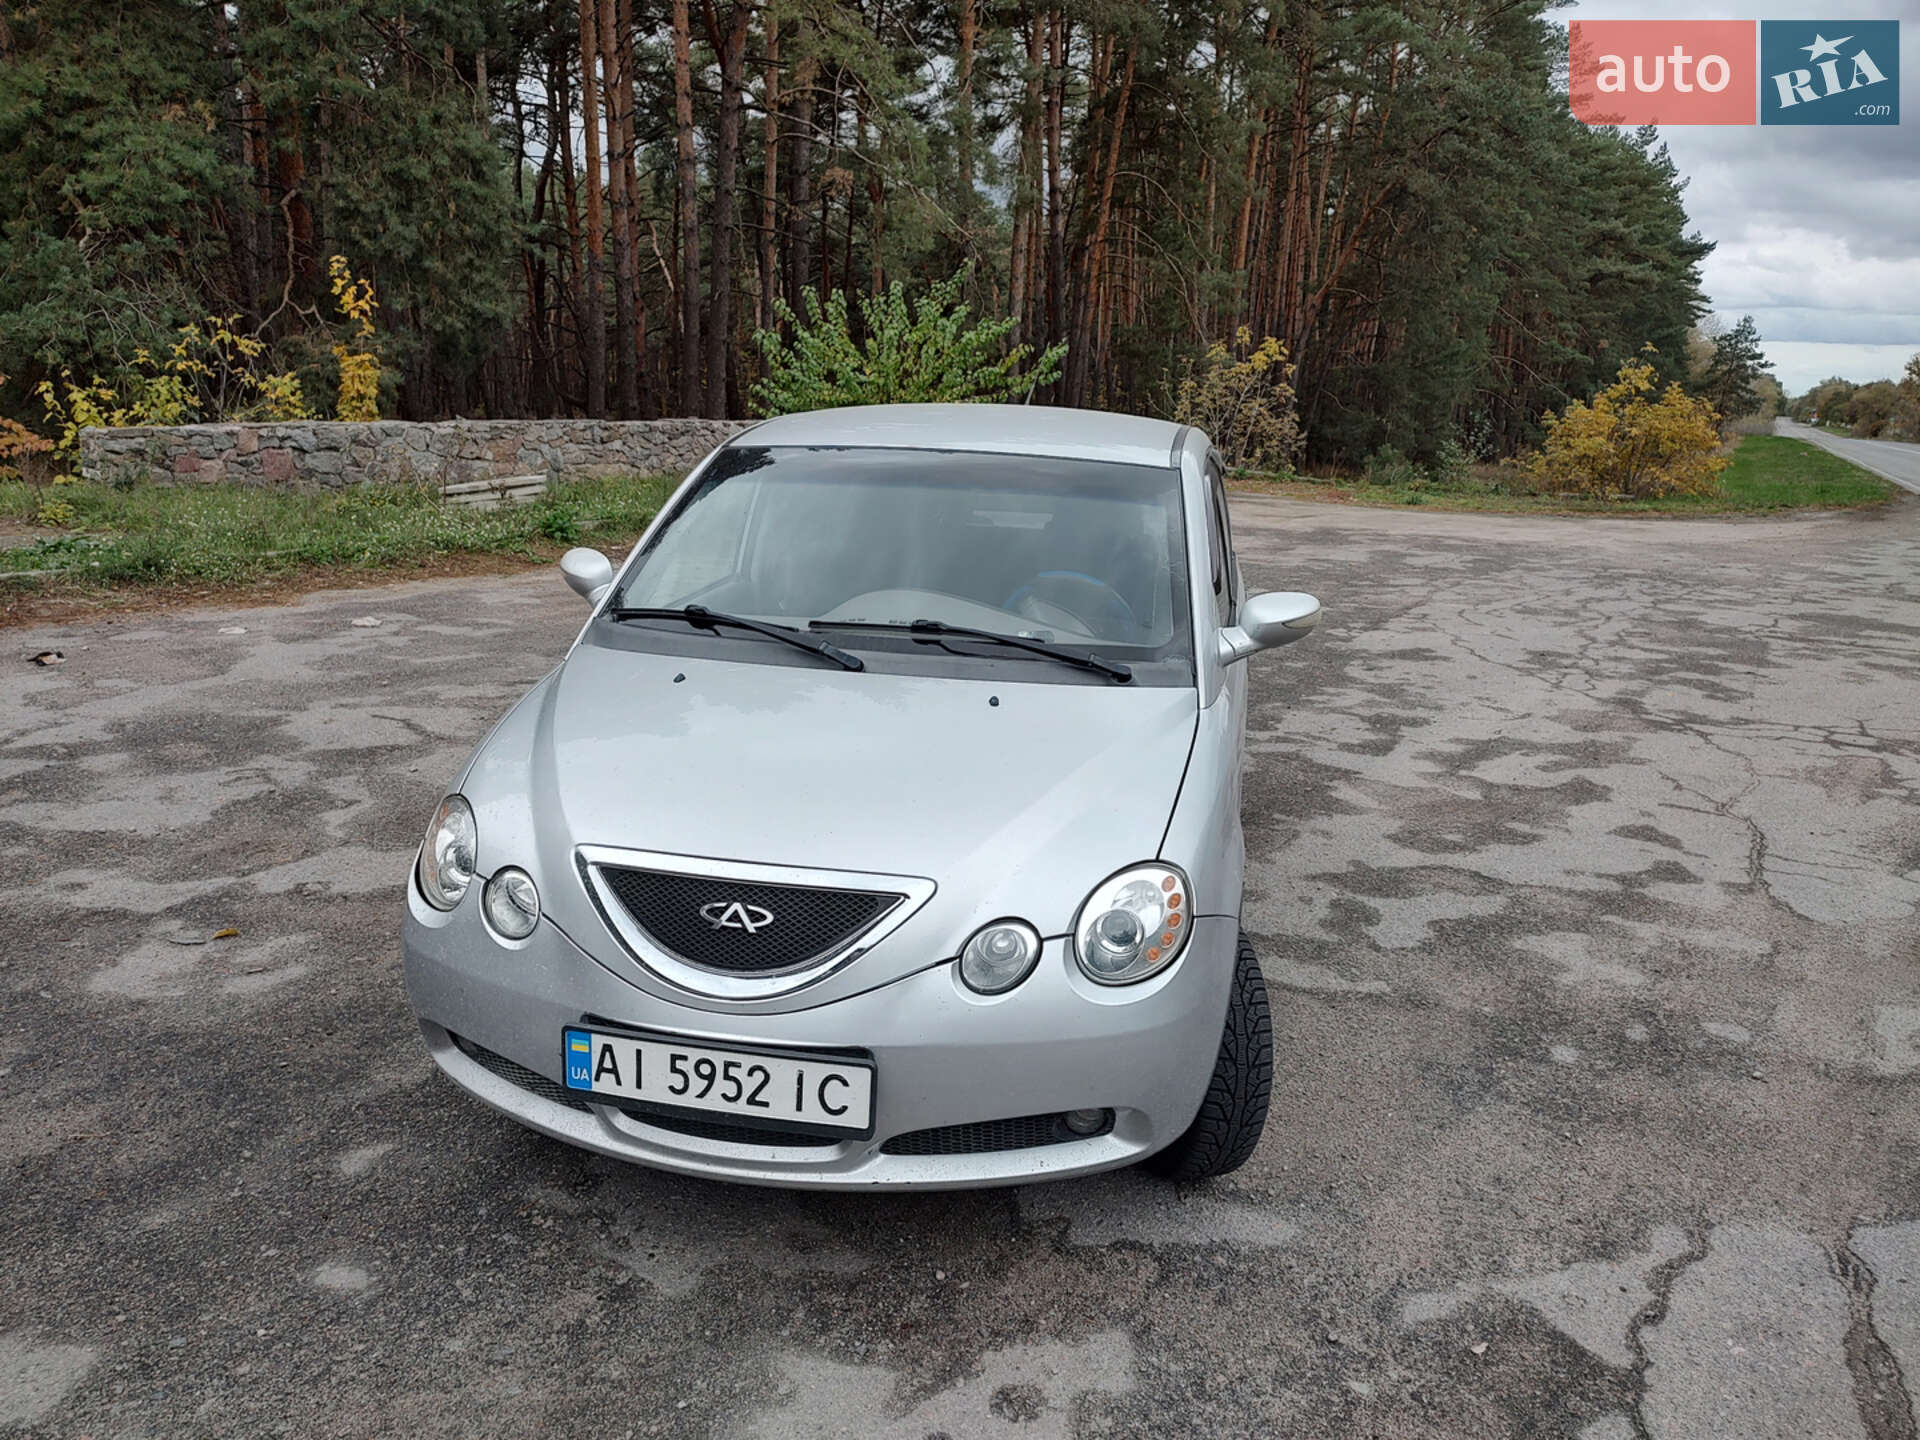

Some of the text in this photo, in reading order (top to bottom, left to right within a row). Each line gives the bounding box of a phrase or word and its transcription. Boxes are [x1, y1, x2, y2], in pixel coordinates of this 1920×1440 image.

[571, 1067, 590, 1081] UA
[594, 1043, 850, 1116] AI 5952 IC
